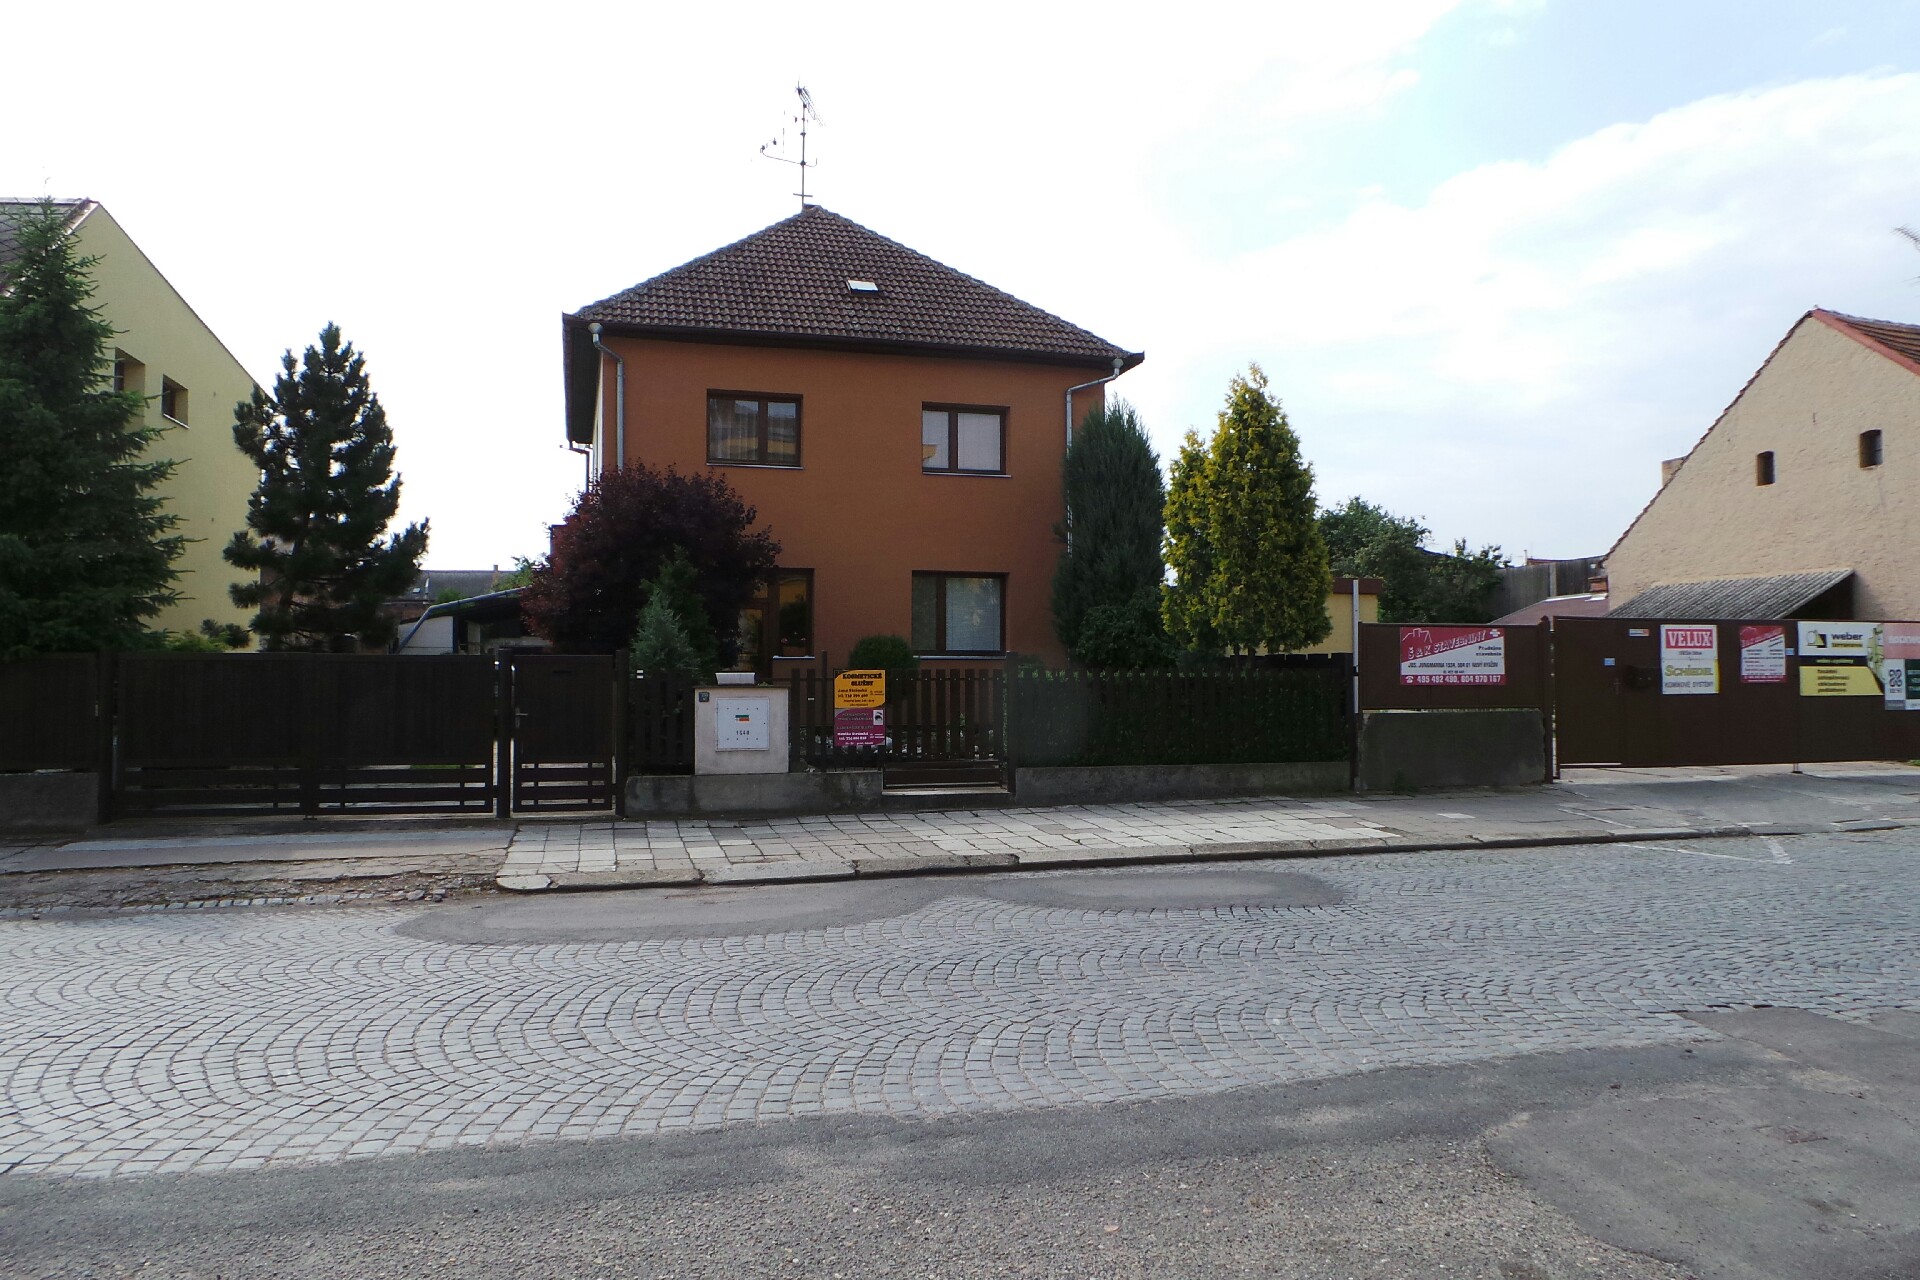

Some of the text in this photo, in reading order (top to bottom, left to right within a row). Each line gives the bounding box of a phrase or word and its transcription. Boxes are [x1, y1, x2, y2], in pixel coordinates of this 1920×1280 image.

[1667, 631, 1711, 647] VELUX
[1831, 632, 1864, 640] weber
[1416, 648, 1424, 658] &
[1423, 644, 1432, 656] K
[1433, 630, 1487, 654] STAVEBNINY
[1417, 675, 1430, 683] 495
[1431, 675, 1444, 683] 492
[1489, 675, 1501, 683] 167
